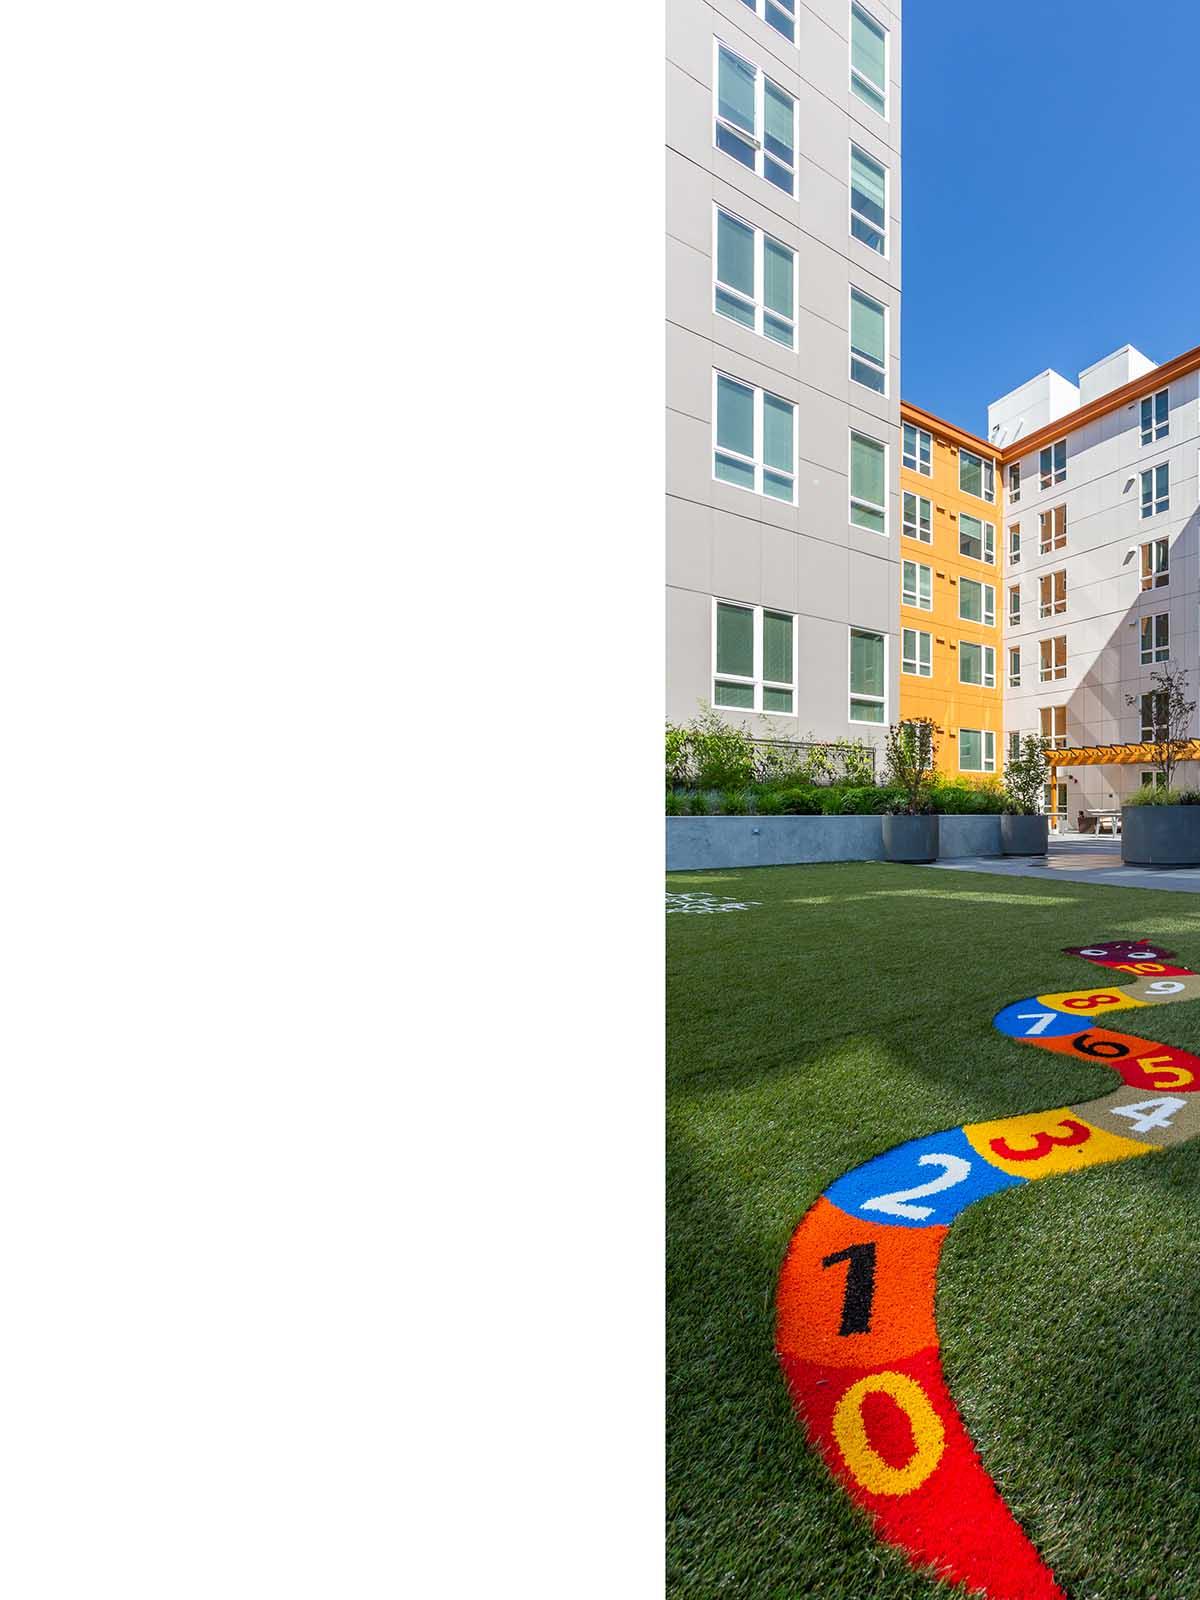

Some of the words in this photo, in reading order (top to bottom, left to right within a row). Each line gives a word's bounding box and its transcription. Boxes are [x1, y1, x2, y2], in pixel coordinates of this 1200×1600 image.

[1115, 963, 1166, 974] 10
[1062, 994, 1120, 1009] 8
[1144, 981, 1186, 994] 9
[1017, 1012, 1057, 1036] 7
[1071, 1034, 1130, 1058] 6
[1136, 1055, 1195, 1089] 5
[1111, 1096, 1188, 1133] 4
[989, 1119, 1091, 1161] 3
[859, 1152, 972, 1221] 2
[821, 1241, 880, 1337] 1
[832, 1370, 946, 1496] 0
